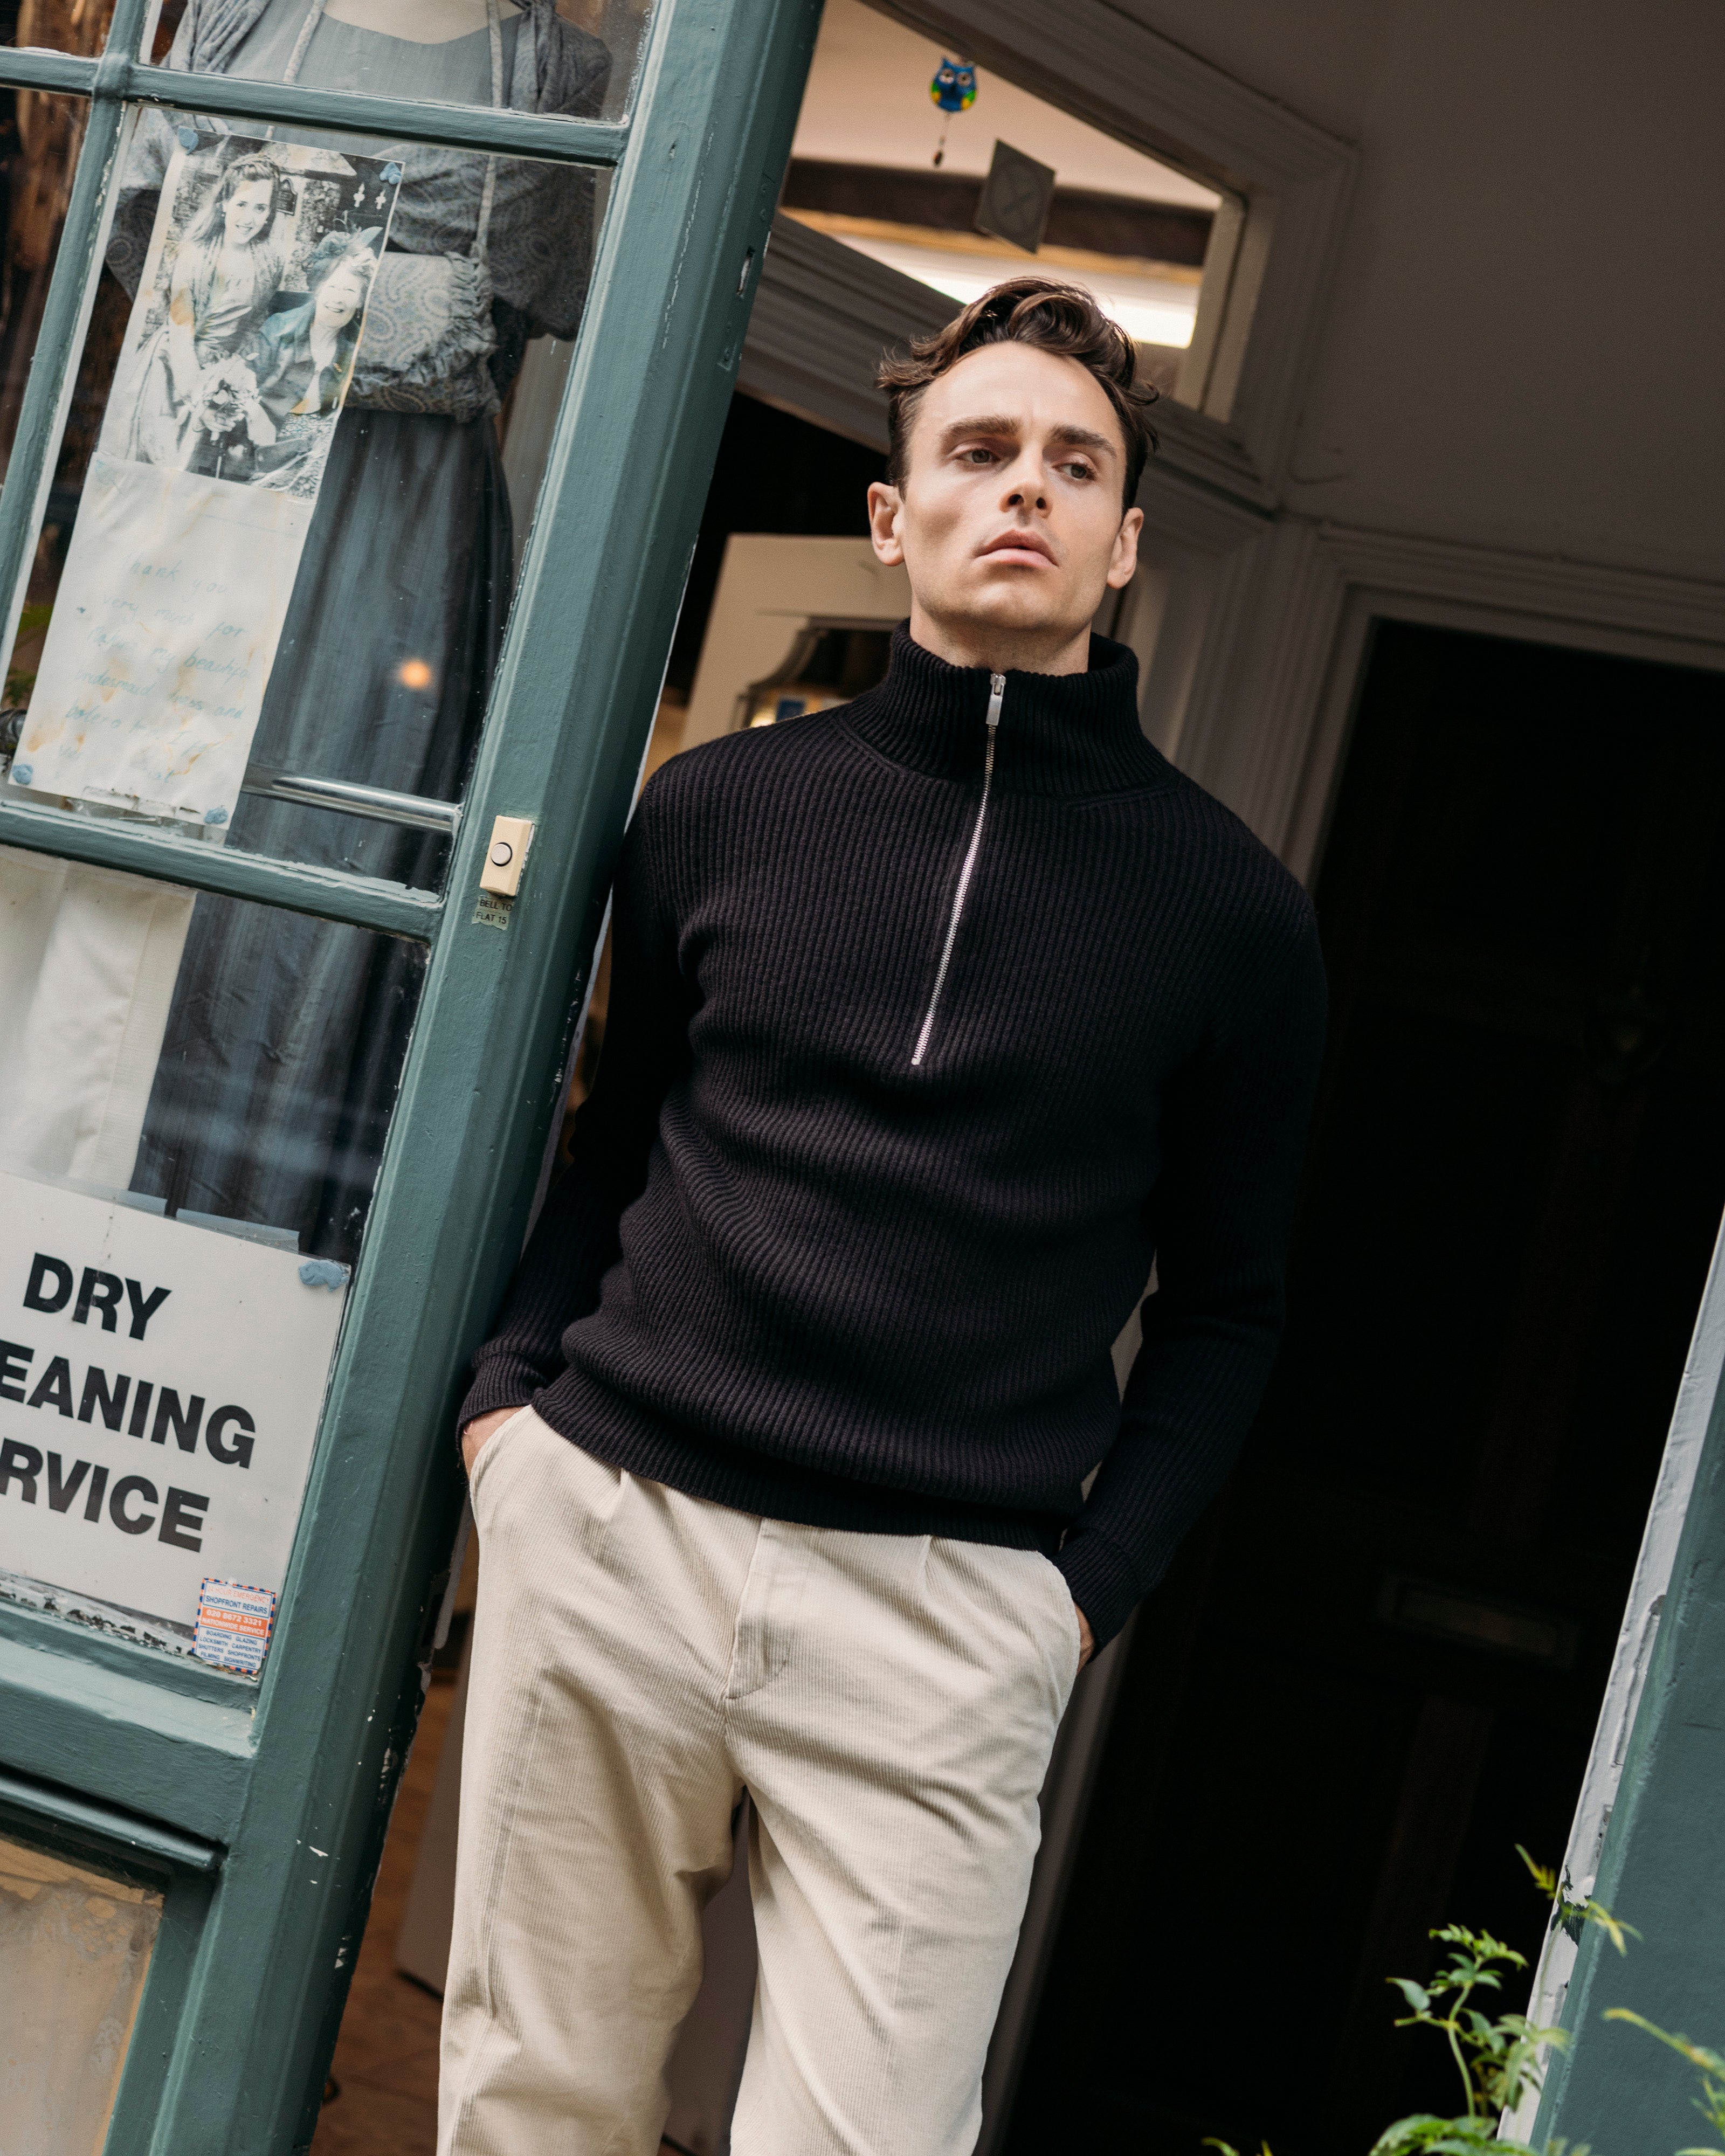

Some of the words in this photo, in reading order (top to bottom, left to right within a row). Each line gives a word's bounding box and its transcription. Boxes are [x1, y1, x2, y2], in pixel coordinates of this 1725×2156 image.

[123, 553, 182, 582] hank
[205, 621, 244, 641] for
[213, 705, 249, 720] and
[479, 899, 499, 910] BELL
[502, 903, 513, 912] TO
[475, 911, 495, 922] FLAT
[499, 916, 507, 924] 15
[23, 1252, 172, 1341] DRY
[0, 1339, 256, 1469] EANING
[0, 1438, 210, 1553] RVICE
[206, 1595, 242, 1609] SHOPFRONT
[242, 1603, 268, 1614] REPAIRS
[216, 1587, 232, 1595] HOUR
[233, 1590, 269, 1604] EMERGENCY
[206, 1609, 222, 1618] 020
[222, 1612, 242, 1623] 8672
[243, 1616, 263, 1626] 3321
[202, 1618, 239, 1630] NATIONWIDE
[239, 1625, 265, 1636] SERVICE
[199, 1636, 228, 1646] LOCKSMITH
[231, 1642, 261, 1654] CARPENTRY
[206, 1630, 232, 1640] BOARDING
[235, 1636, 258, 1645] GLAZING
[198, 1643, 224, 1653] SHUTTERS
[227, 1649, 261, 1661] SHOPFRONTS
[201, 1651, 220, 1660] FILMING
[224, 1656, 257, 1668] SIGNWRITING
